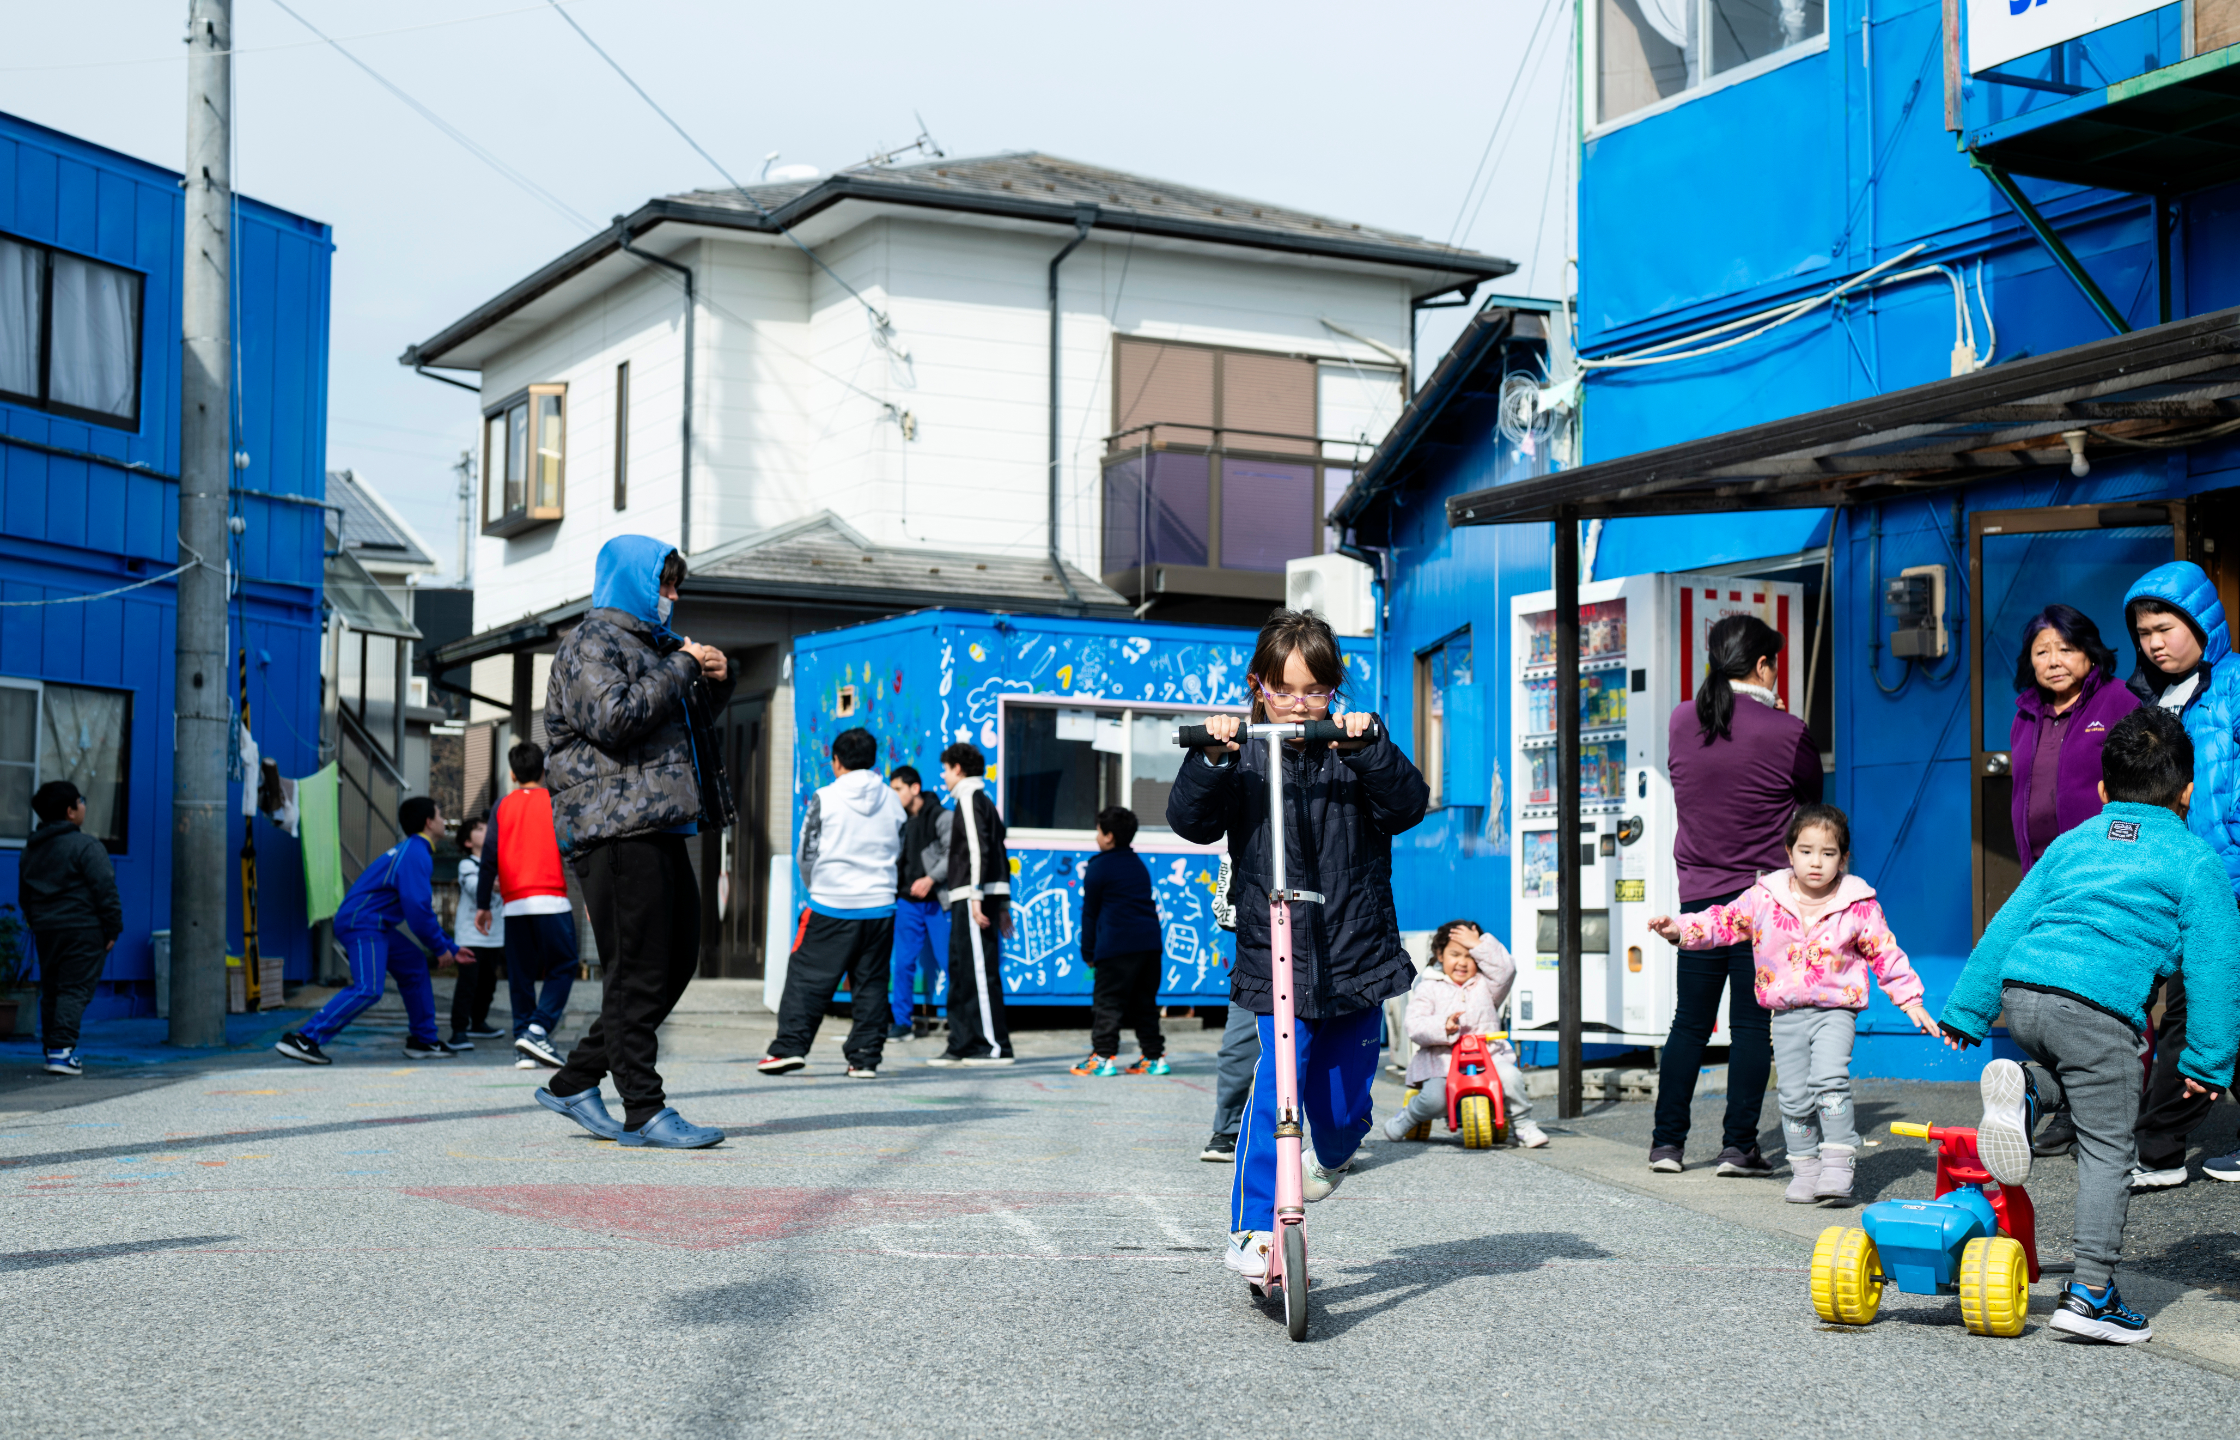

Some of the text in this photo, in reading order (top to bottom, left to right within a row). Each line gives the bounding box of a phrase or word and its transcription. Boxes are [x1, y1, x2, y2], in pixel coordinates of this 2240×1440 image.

[1144, 683, 1155, 700] 9
[1164, 682, 1176, 701] 7
[980, 719, 998, 749] 6
[1057, 856, 1073, 876] 5
[1167, 857, 1188, 887] 1
[1216, 862, 1228, 899] BRIGHT
[1036, 969, 1047, 987] 3
[1055, 956, 1072, 978] 2
[1167, 964, 1182, 991] 4
